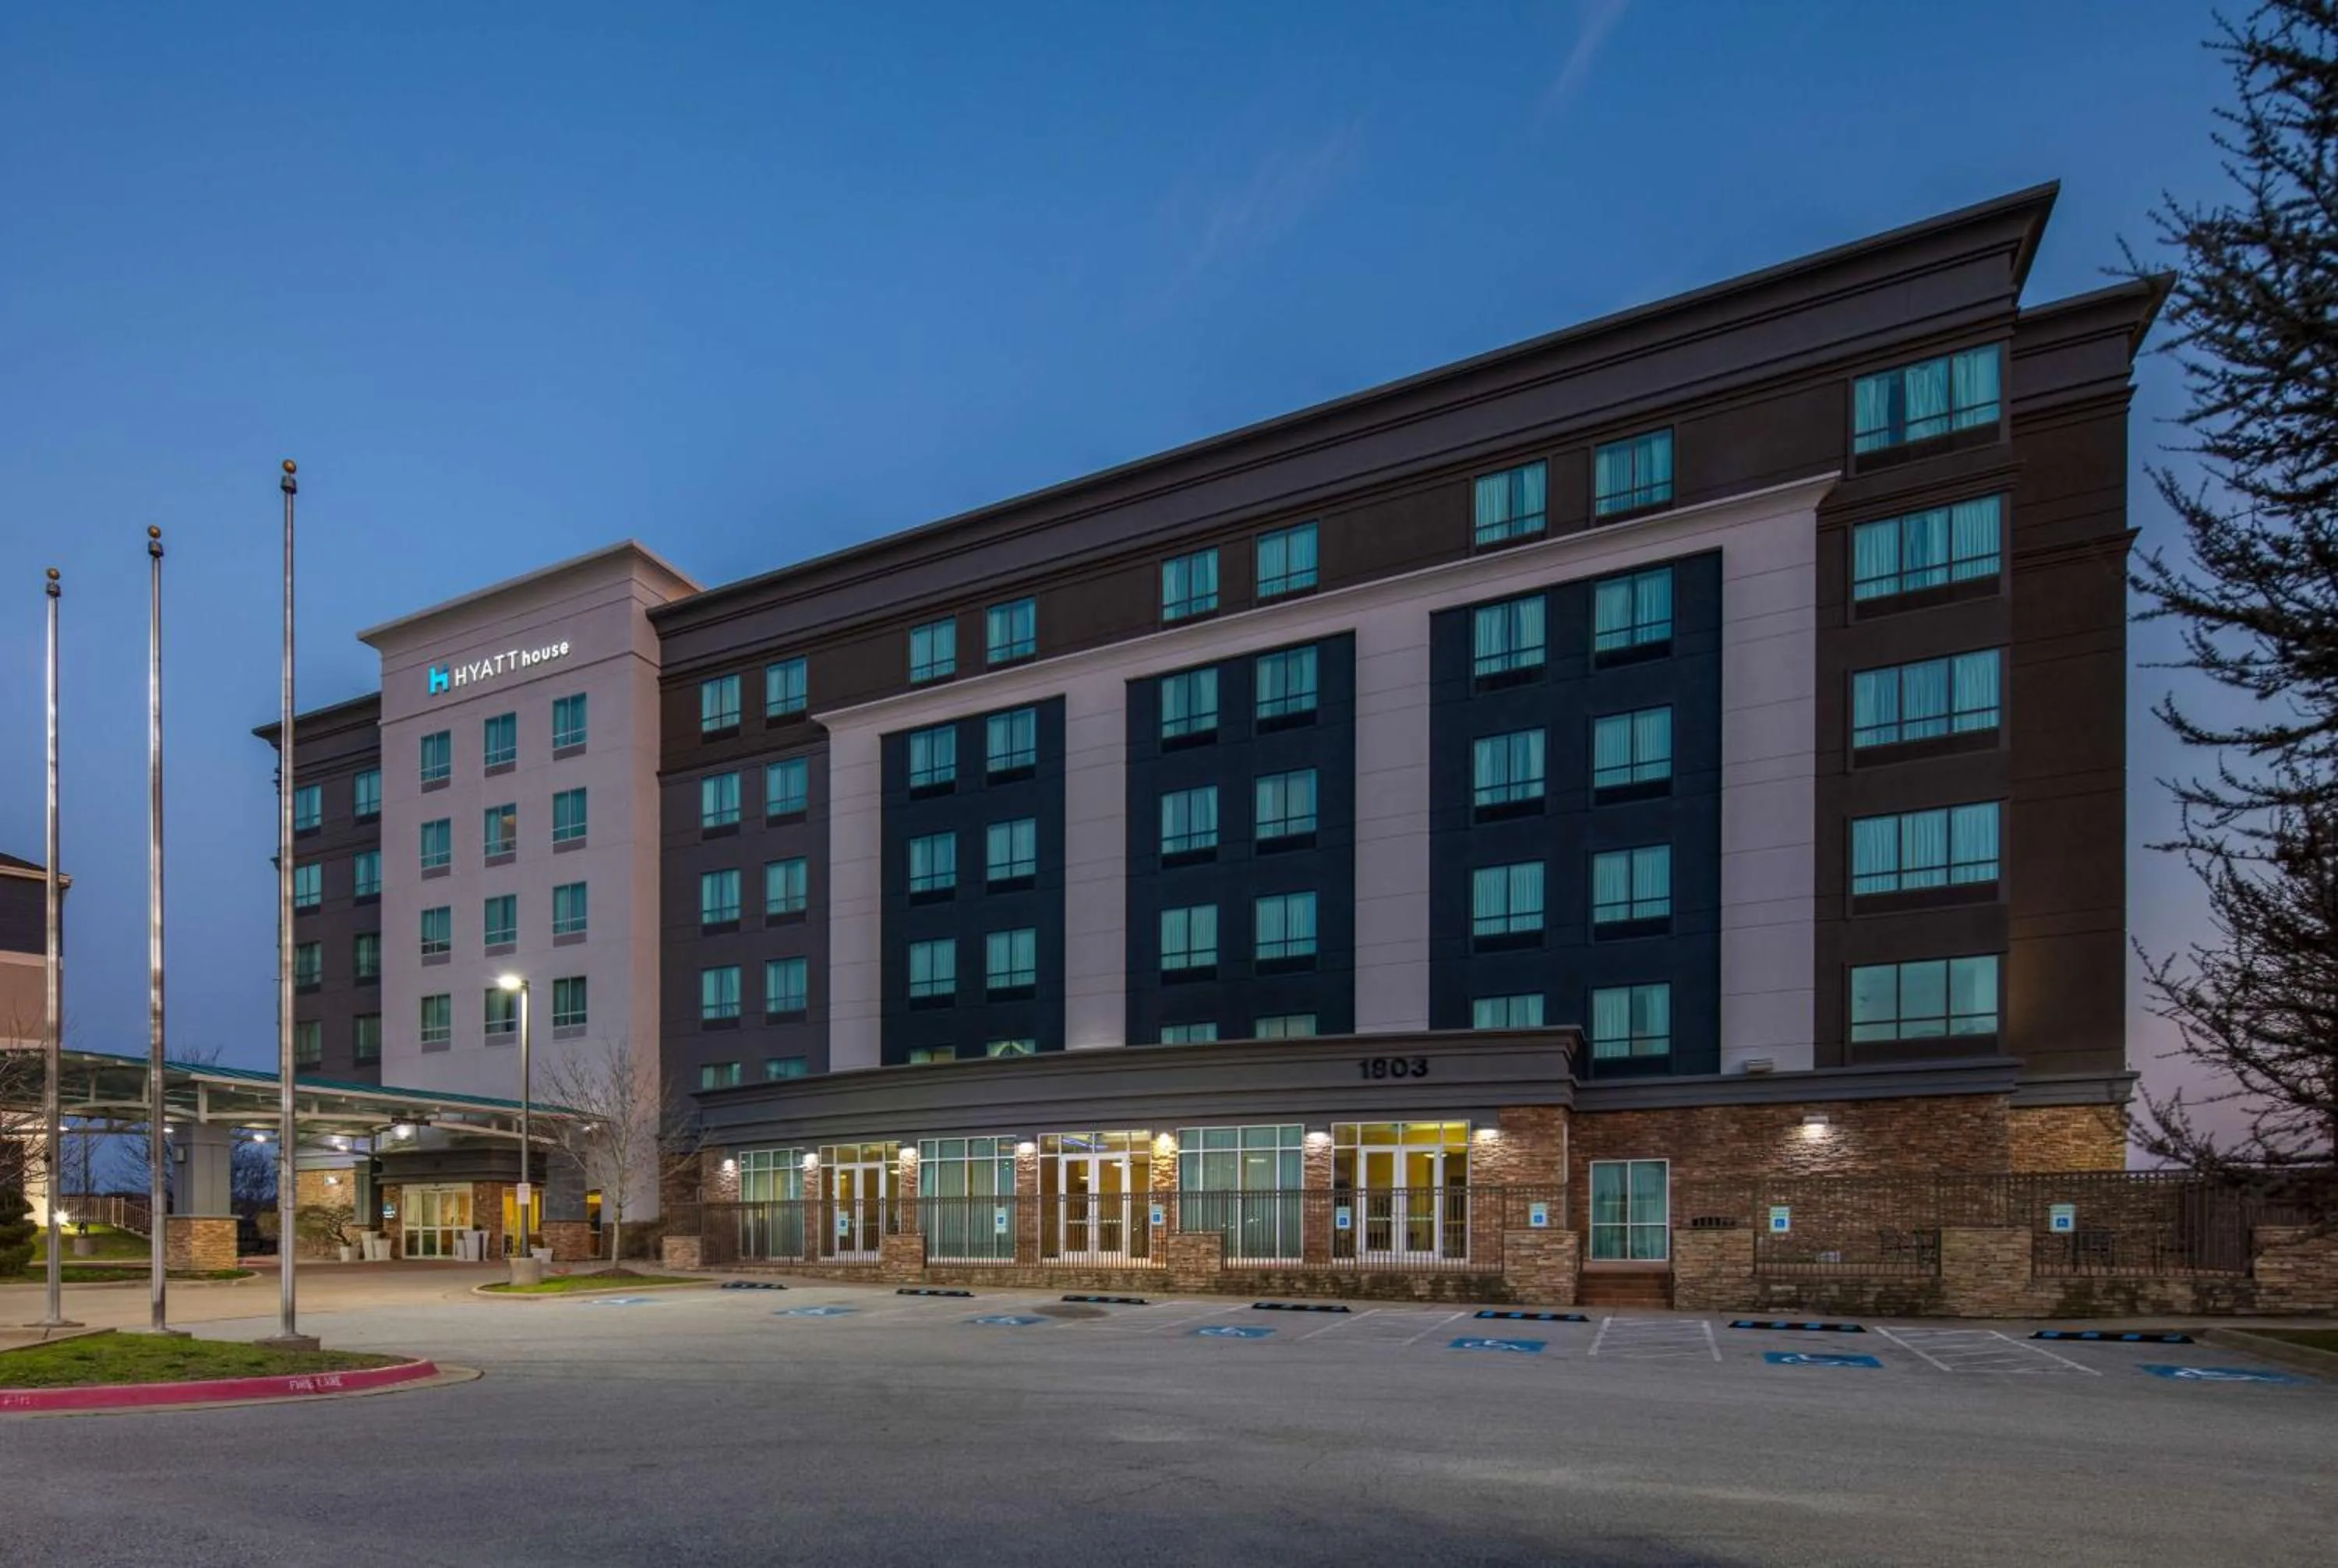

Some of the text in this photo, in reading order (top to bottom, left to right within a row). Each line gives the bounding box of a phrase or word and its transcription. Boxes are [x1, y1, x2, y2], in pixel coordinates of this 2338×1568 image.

[454, 650, 518, 687] HYATT
[521, 641, 570, 666] house
[1358, 1056, 1429, 1079] 1803
